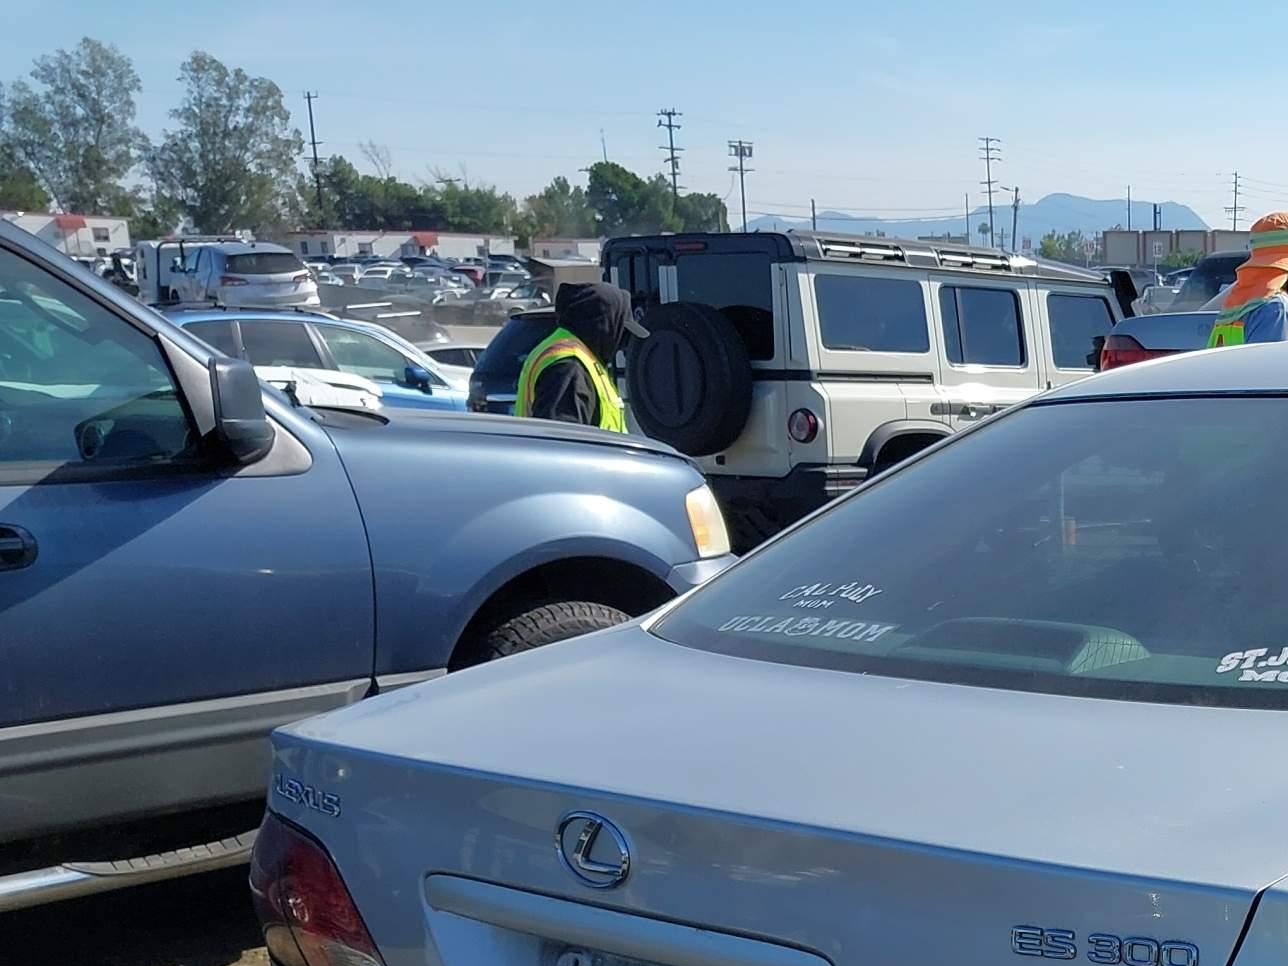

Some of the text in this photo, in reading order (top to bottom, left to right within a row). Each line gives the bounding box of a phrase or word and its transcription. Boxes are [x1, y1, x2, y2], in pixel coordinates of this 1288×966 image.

[779, 583, 832, 601] CAL
[792, 599, 836, 609] MOM
[717, 615, 896, 643] UCLA MOM
[276, 774, 341, 817] LEXUS
[1011, 924, 1077, 961] ES
